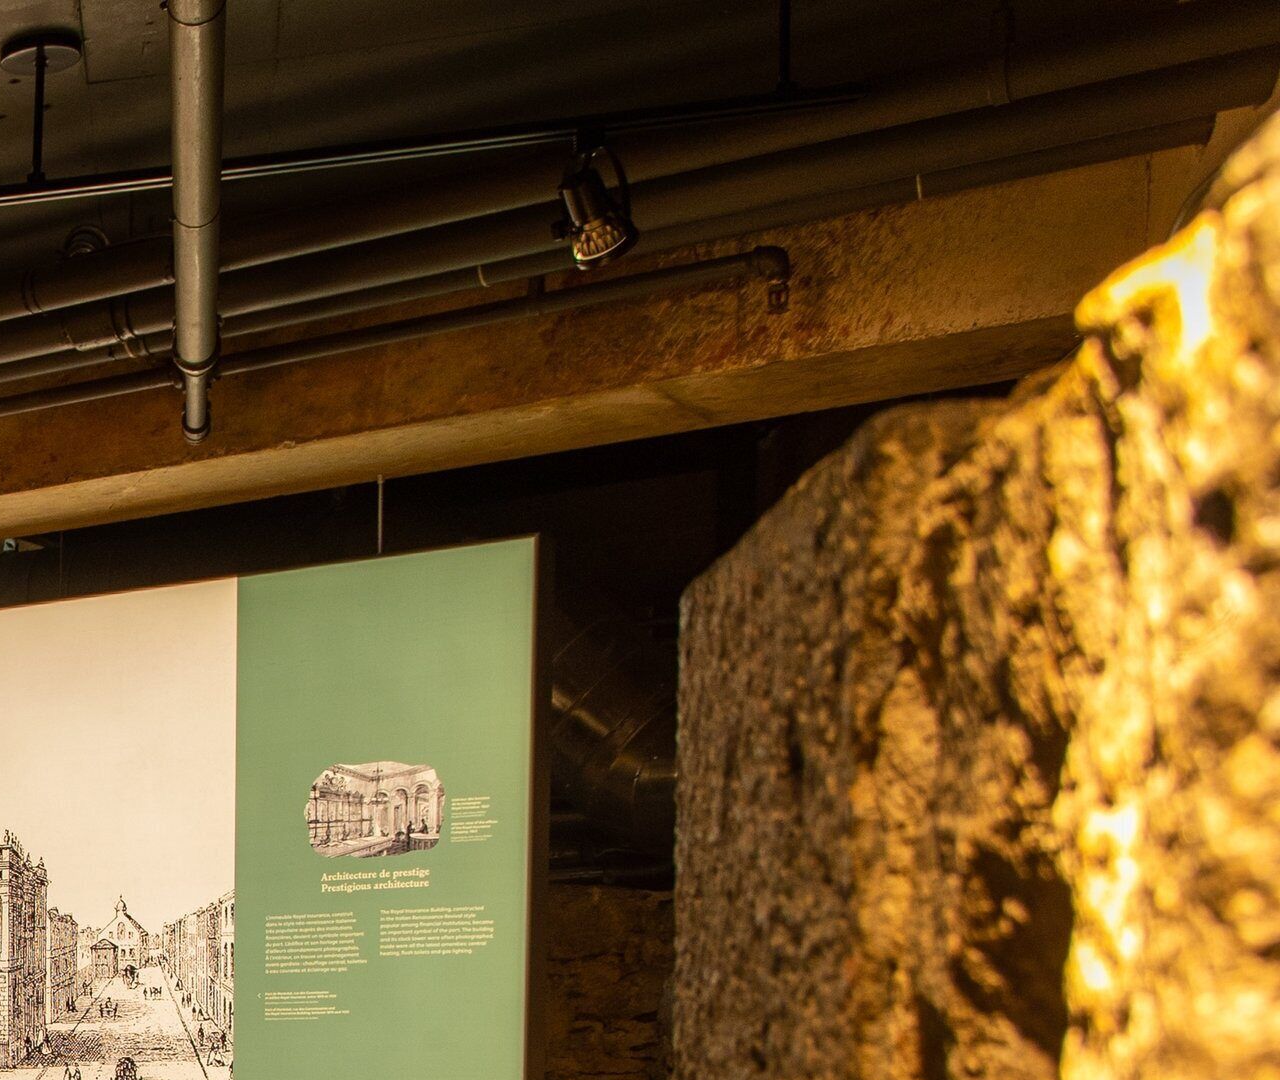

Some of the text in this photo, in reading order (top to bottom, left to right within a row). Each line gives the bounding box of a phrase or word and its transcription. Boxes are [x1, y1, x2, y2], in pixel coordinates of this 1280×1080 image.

[321, 868, 430, 881] Architecture de prestige
[322, 880, 429, 893] Prestigious architecture
